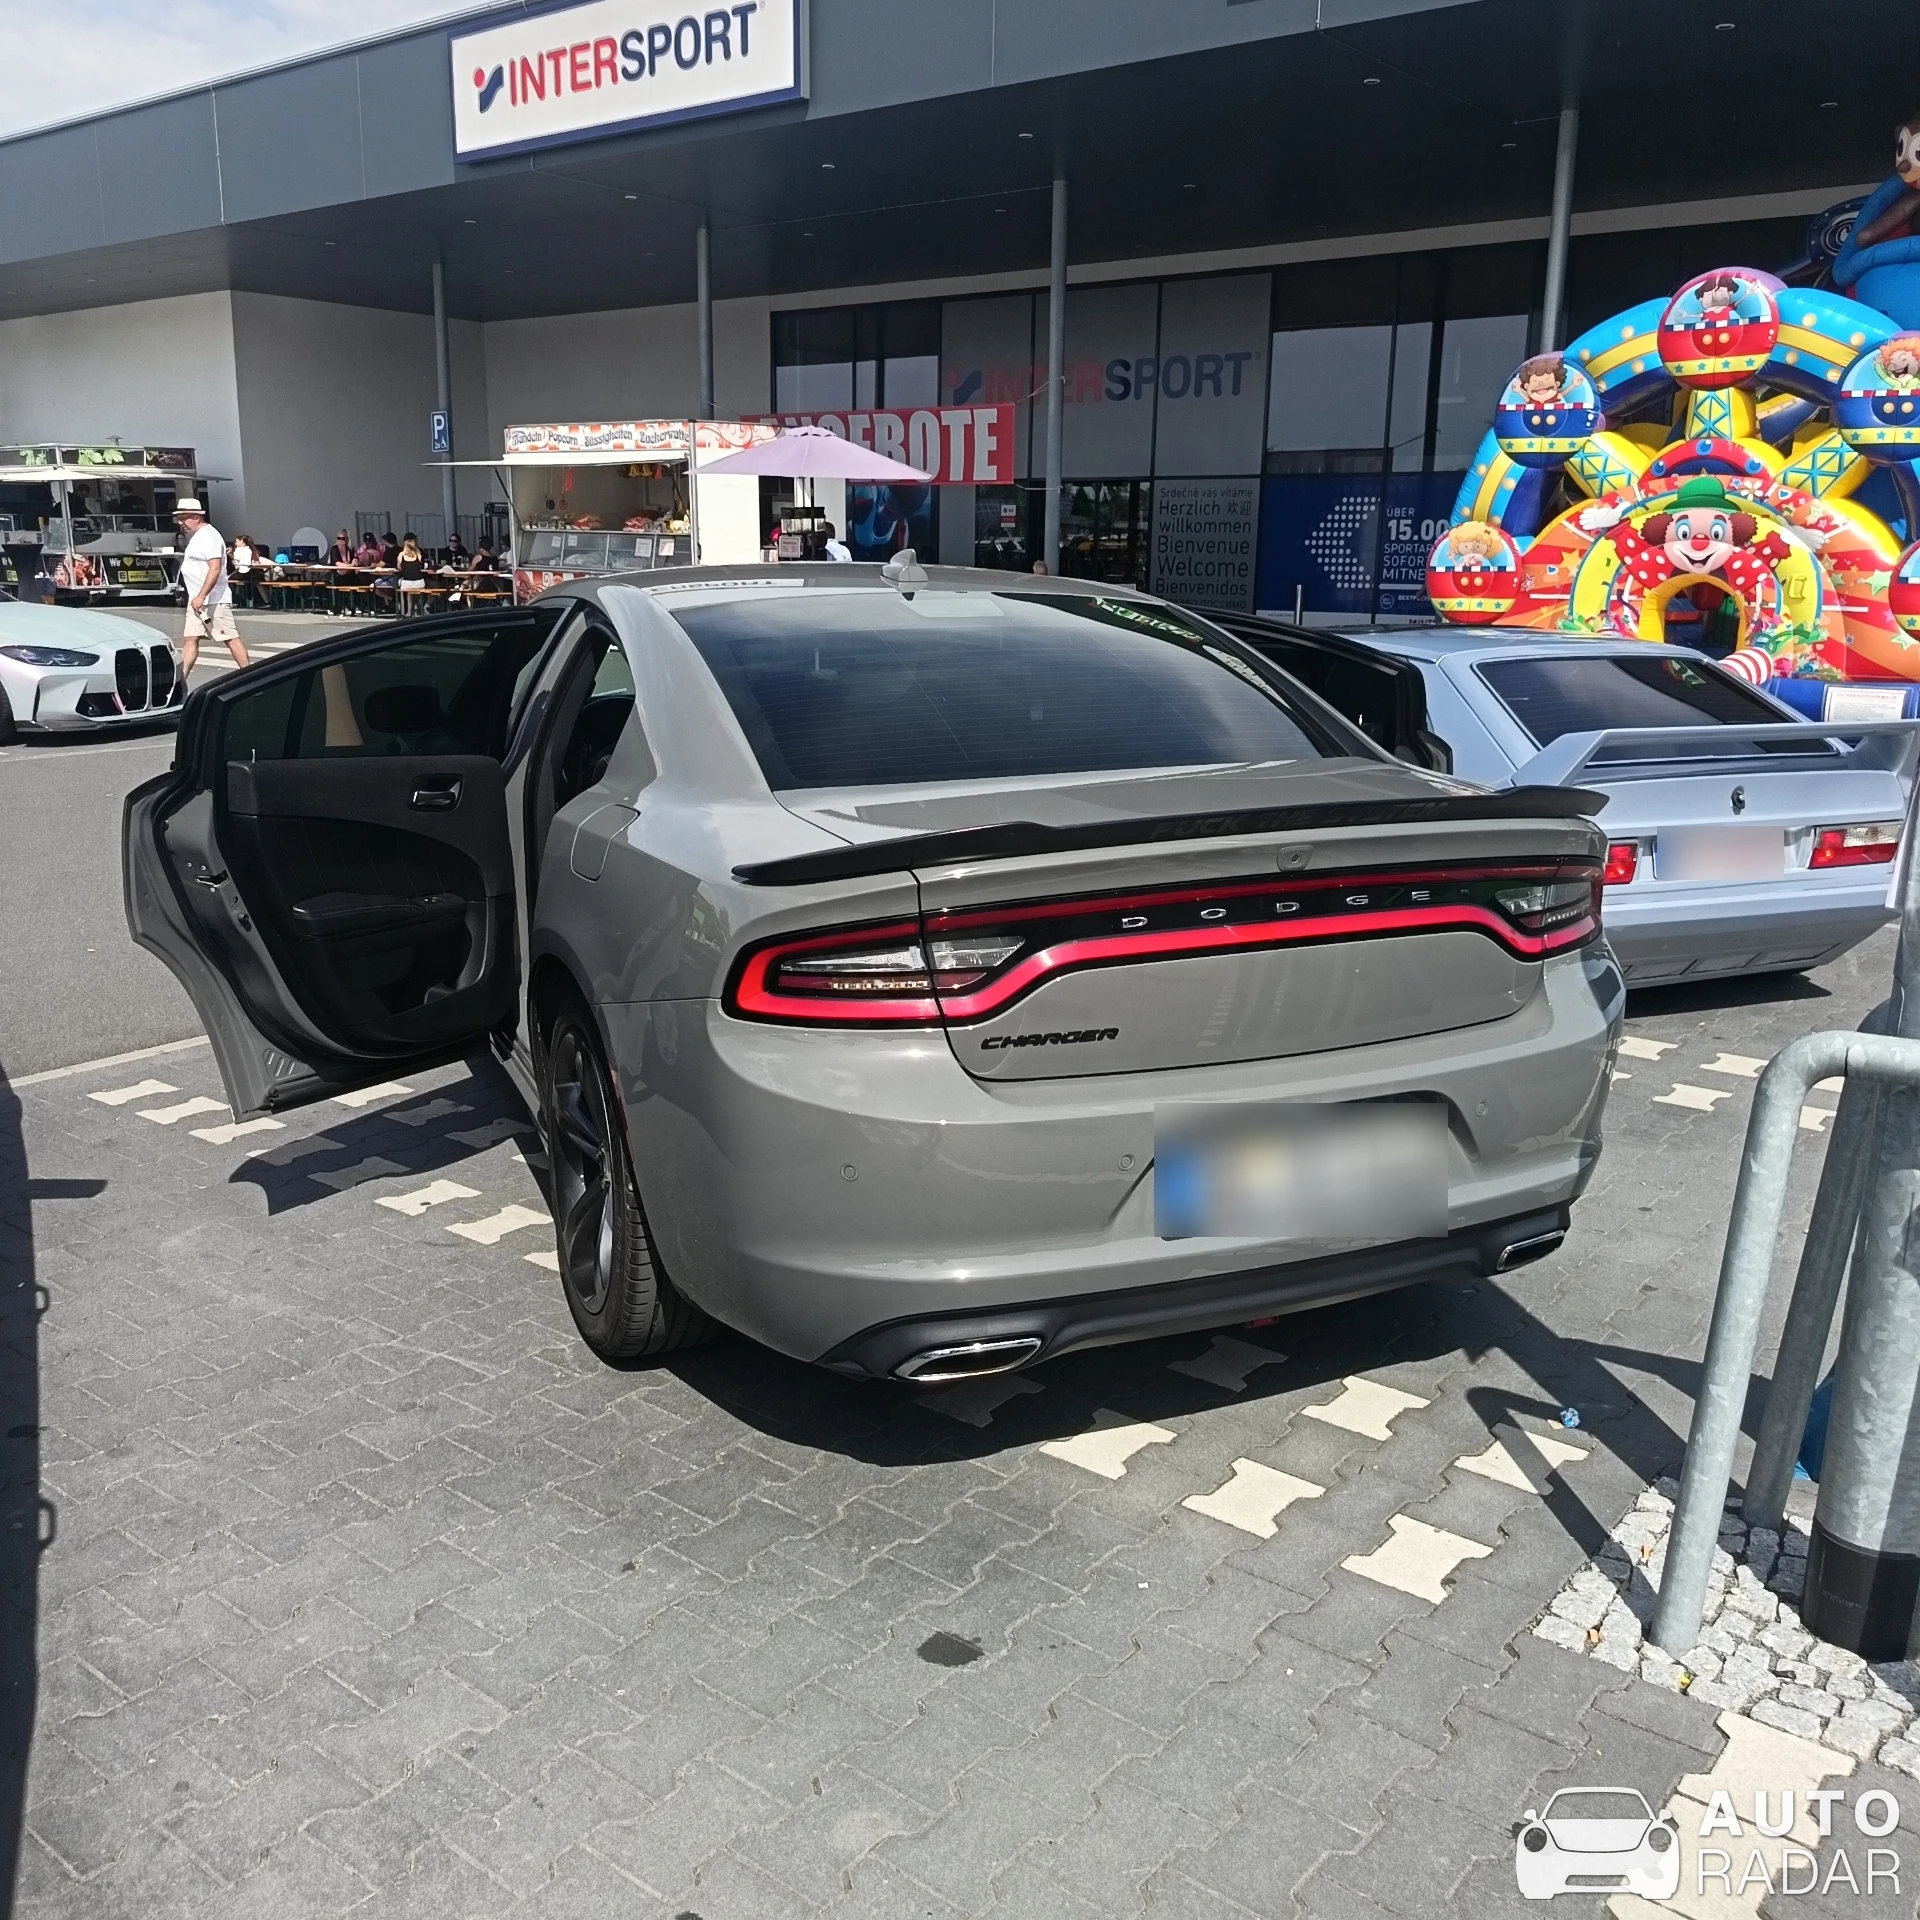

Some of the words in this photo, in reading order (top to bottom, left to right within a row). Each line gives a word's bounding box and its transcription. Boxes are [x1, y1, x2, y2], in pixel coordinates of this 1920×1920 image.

[509, 2, 758, 107] INTERSPORT
[433, 414, 445, 440] P
[548, 431, 578, 446] Popcorn
[639, 428, 690, 444] Zuckerwatte
[758, 408, 998, 484] EBOTE
[1201, 488, 1217, 498] vás
[1220, 487, 1253, 498] vítáme
[1159, 500, 1220, 516] Herzlich
[1227, 501, 1252, 516] 欢迎
[1386, 505, 1415, 517] ÜBER
[1159, 517, 1251, 533] willkommen
[1157, 535, 1250, 554] Bienvenue
[1157, 556, 1249, 577] Welcome
[1383, 555, 1428, 567] SOFOR
[1155, 578, 1248, 596] Bienvenidos
[1151, 814, 1247, 839] FUCK
[1256, 808, 1314, 830] THE
[1321, 801, 1449, 823] SYSTEM
[1121, 890, 1431, 929] DODGE
[980, 1027, 1120, 1050] CHARGER
